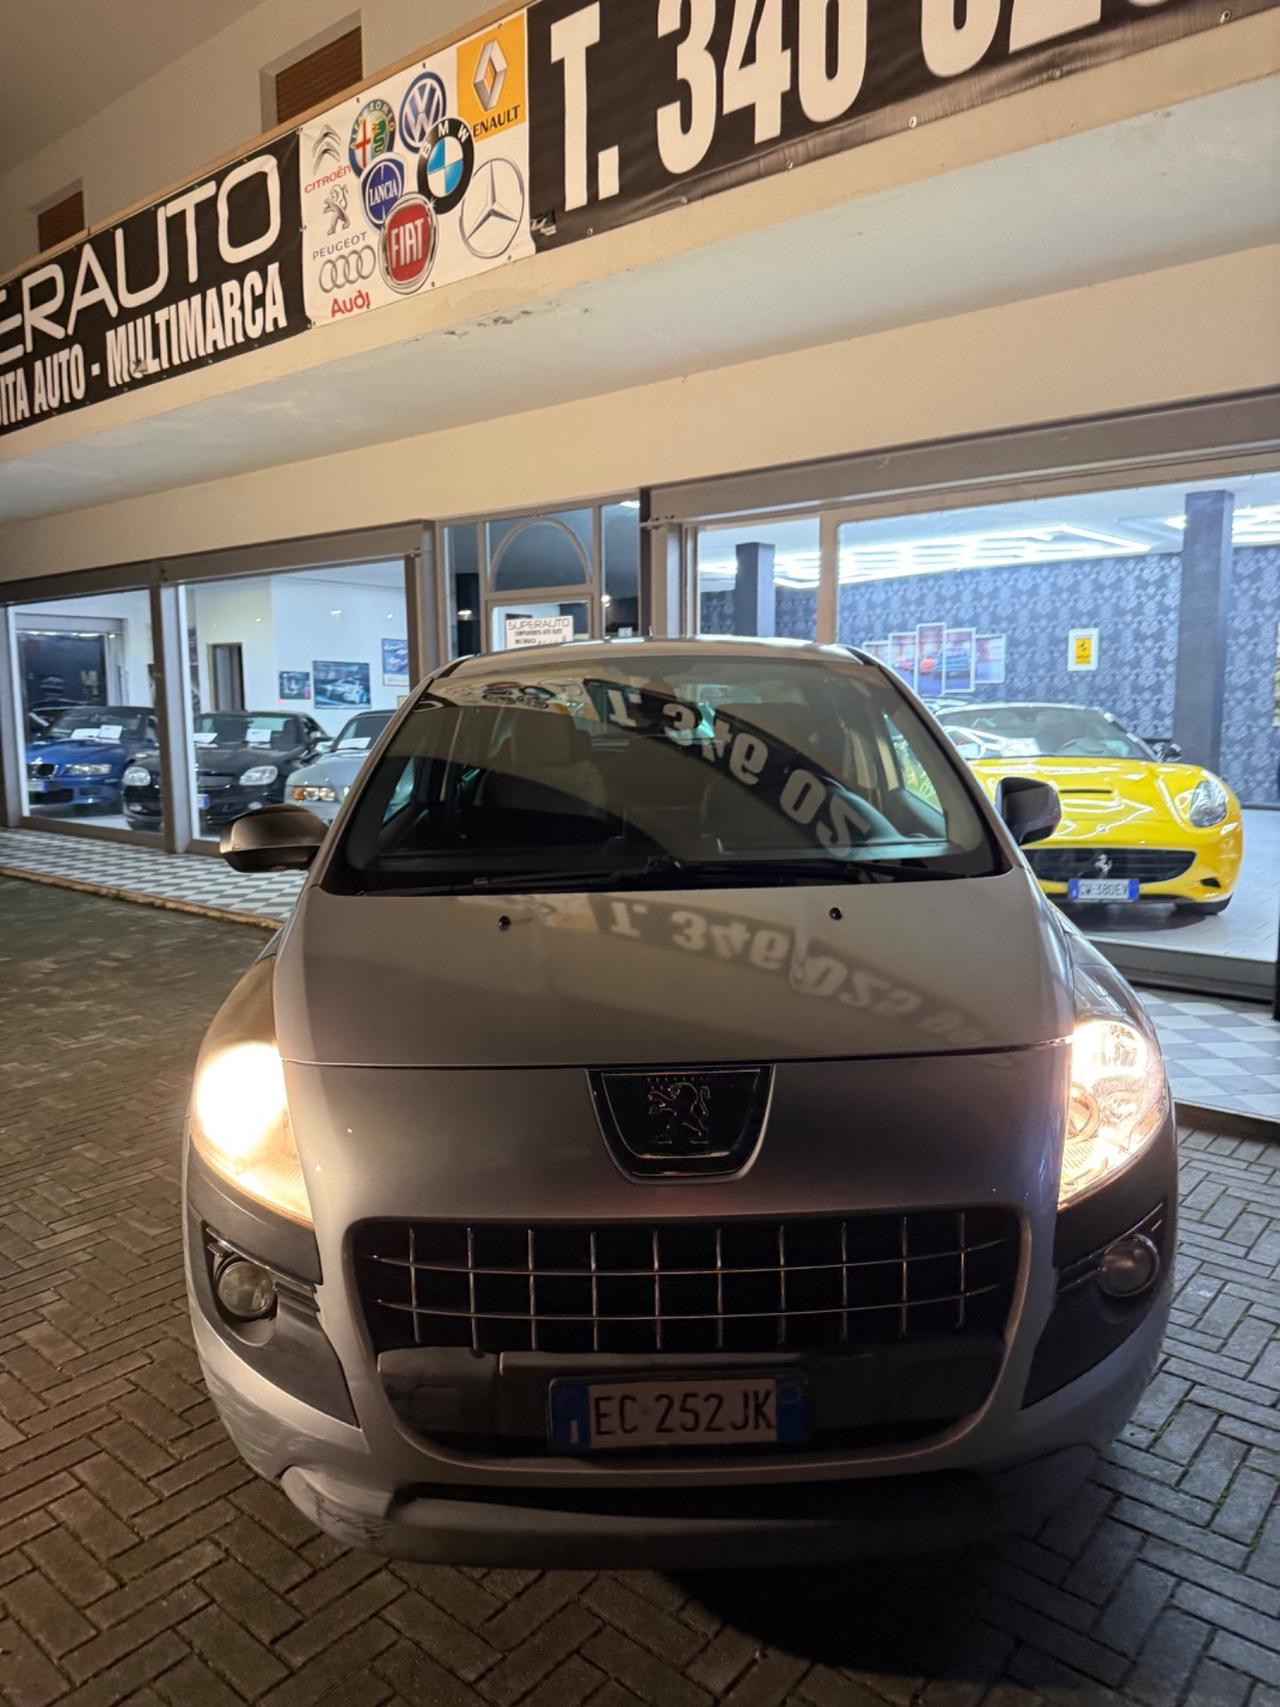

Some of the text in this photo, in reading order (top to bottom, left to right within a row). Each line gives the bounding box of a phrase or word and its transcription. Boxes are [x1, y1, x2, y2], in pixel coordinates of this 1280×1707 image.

[473, 105, 520, 137] ENAULT
[551, 4, 619, 211] T.
[369, 181, 398, 206] LANCIA
[312, 232, 368, 261] PEUGEOT
[391, 217, 424, 269] FIAT
[331, 289, 372, 318] Audi
[0, 367, 30, 425] ITA
[34, 343, 86, 414] AUTO
[106, 262, 287, 387] MULTIMARCA
[593, 1394, 640, 1436] EC
